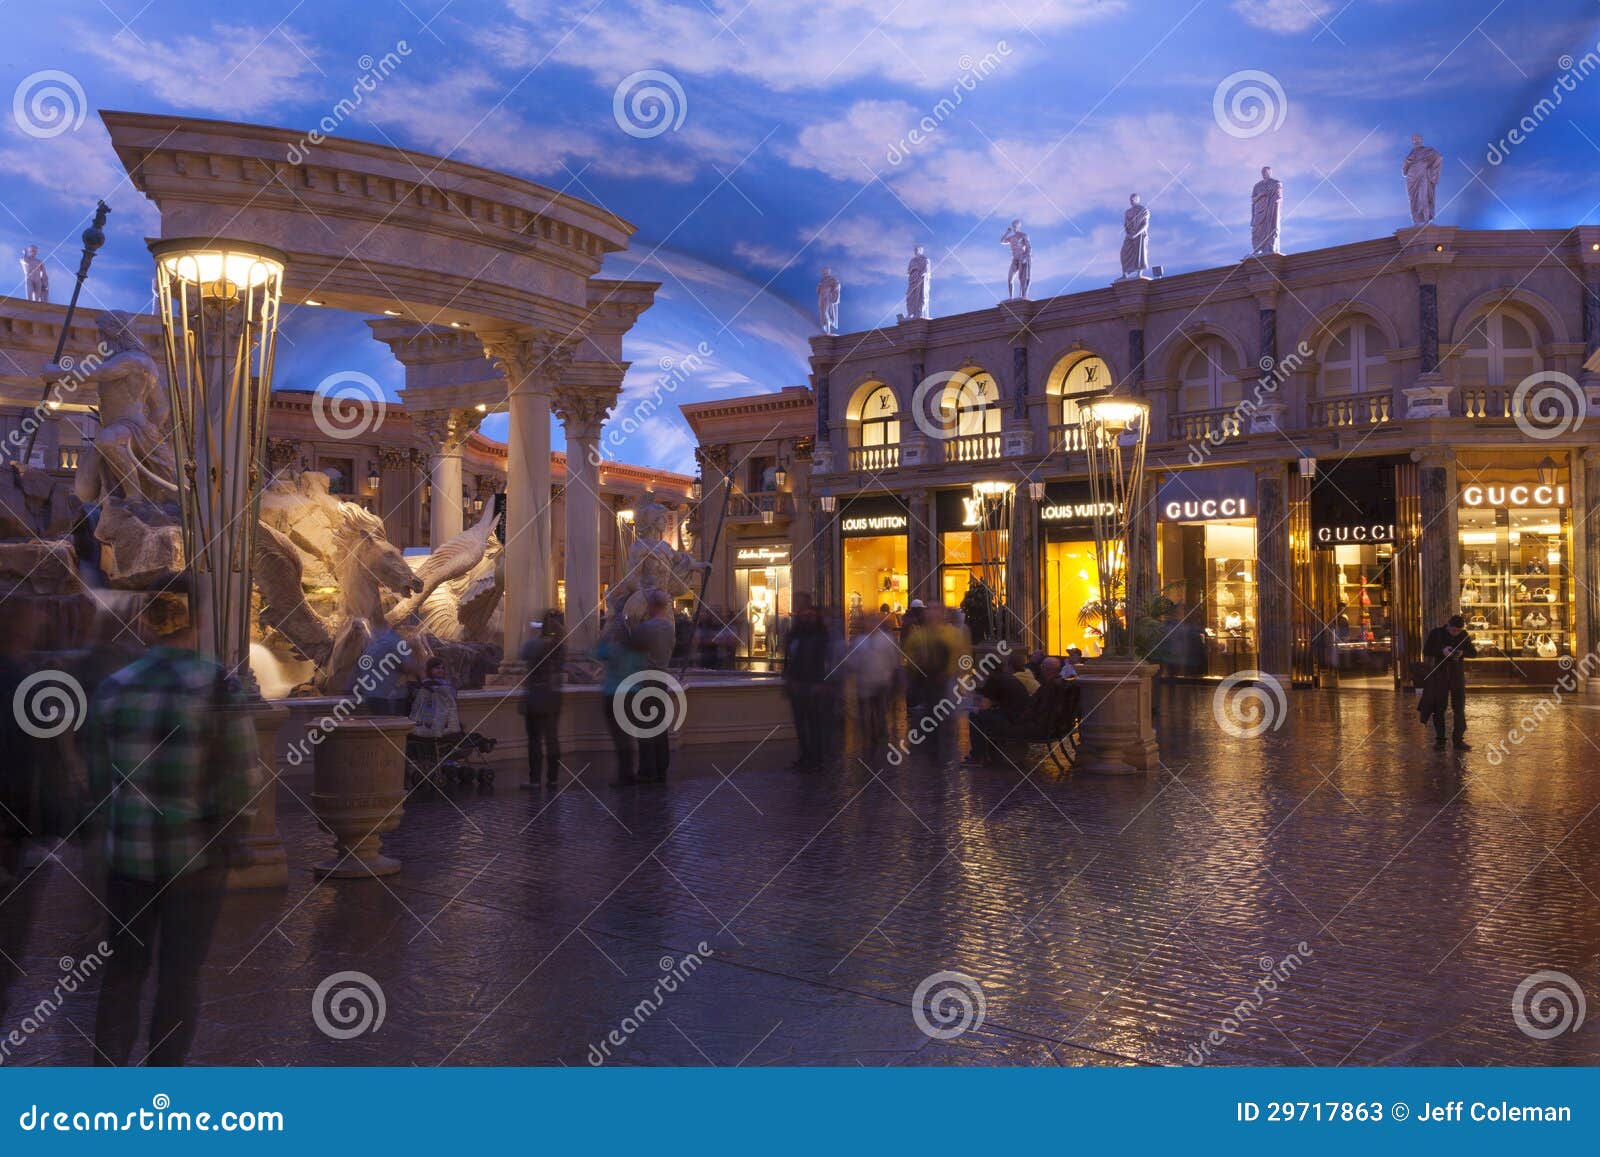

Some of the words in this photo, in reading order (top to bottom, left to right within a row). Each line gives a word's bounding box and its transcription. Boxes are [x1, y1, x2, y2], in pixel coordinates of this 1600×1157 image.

[1464, 486, 1564, 505] GUCCI
[1041, 505, 1073, 519] LOUIS
[1166, 499, 1246, 518] GUCCI
[842, 518, 867, 530] LOUIS
[868, 516, 907, 529] VUITTON
[1319, 525, 1394, 541] GUCCI
